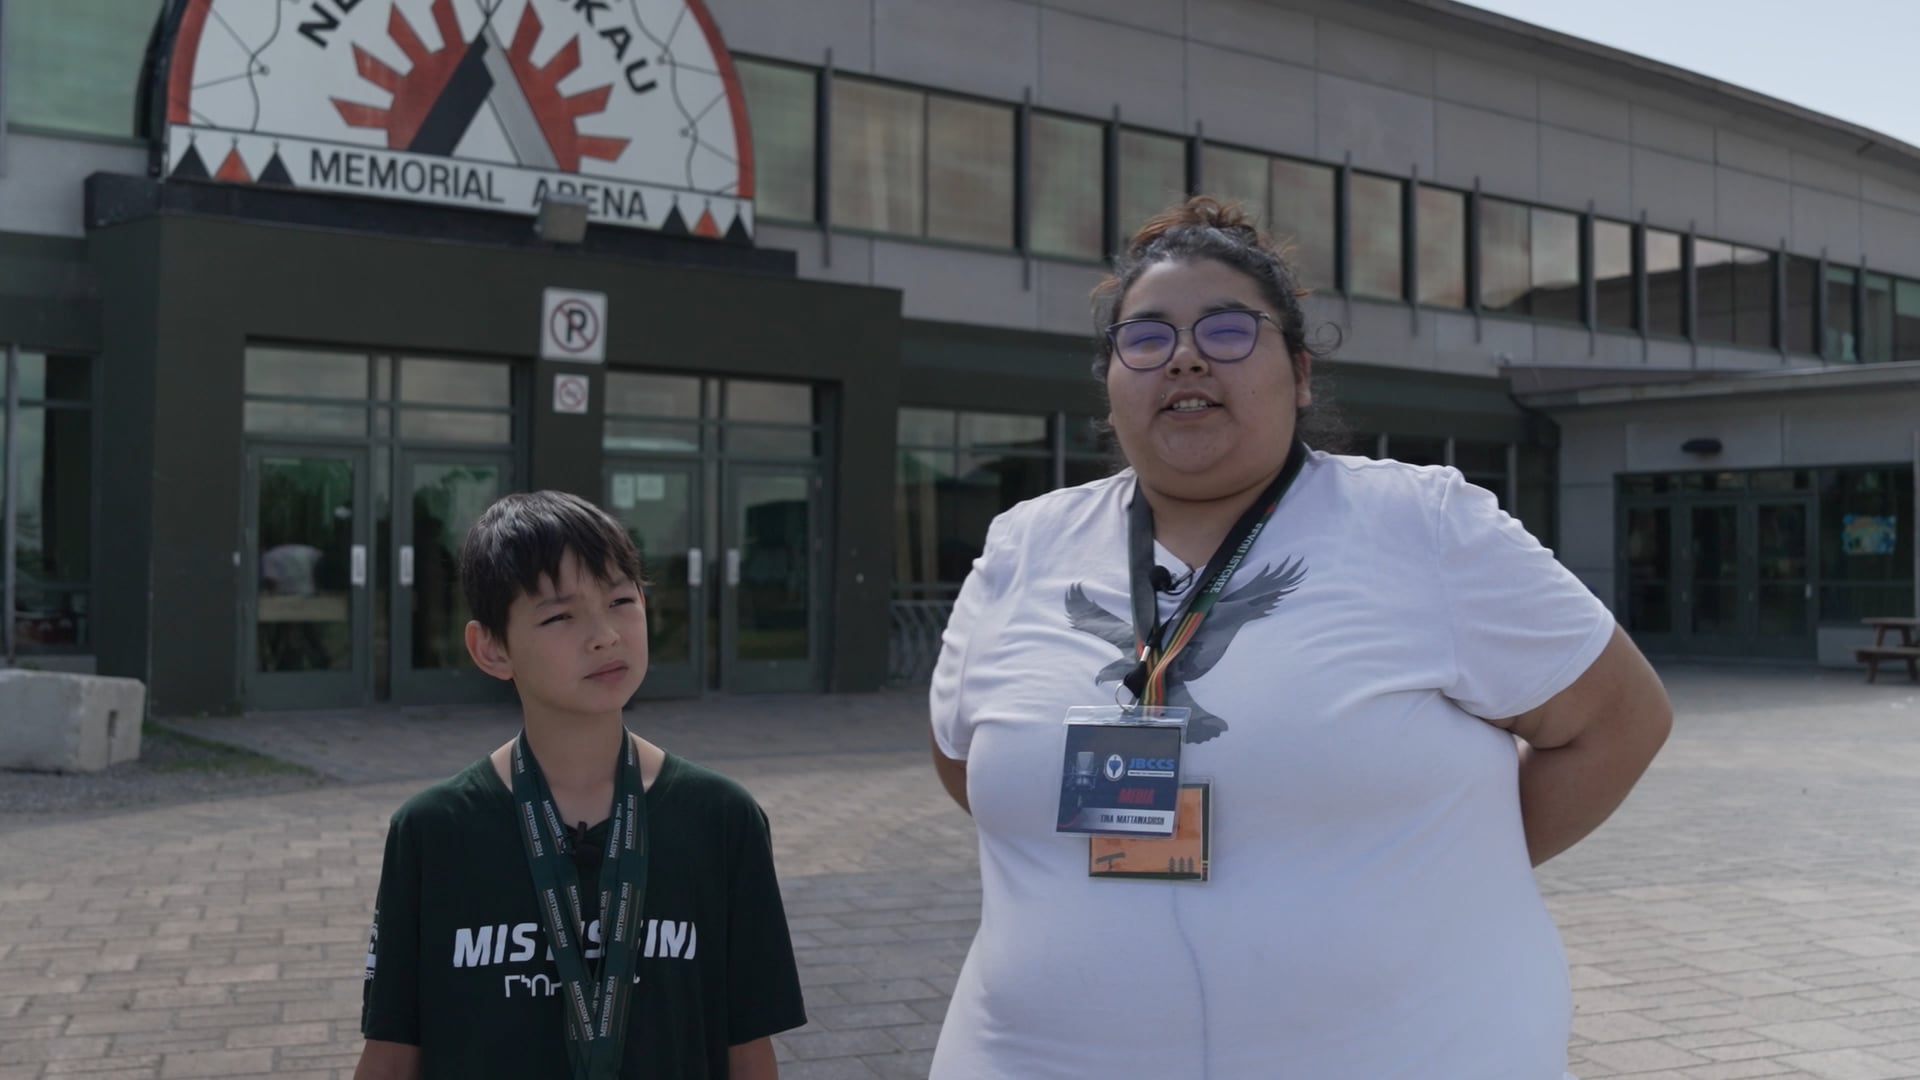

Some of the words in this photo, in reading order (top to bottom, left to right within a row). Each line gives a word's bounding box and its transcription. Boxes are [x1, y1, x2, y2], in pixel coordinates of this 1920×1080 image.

[310, 148, 504, 204] MEMORIAL
[566, 308, 587, 343] P
[1210, 555, 1243, 593] ISTCHEE
[1128, 758, 1175, 769] JBCCS
[524, 800, 541, 839] MISTISSINI
[542, 799, 563, 839] MISTISSINI
[608, 818, 621, 859] MISTISSINI
[625, 811, 634, 850] MISTISSINI
[546, 888, 564, 927] MISTISSINI
[558, 927, 569, 948] 2024
[615, 901, 626, 942] MISTISSINI
[621, 881, 629, 900] 2024
[453, 919, 697, 967] MISSINI
[573, 980, 589, 1022] MISTISSINI
[584, 1023, 595, 1041] 2024
[600, 993, 612, 1038] MISTISSINI
[606, 976, 615, 993] 2024
